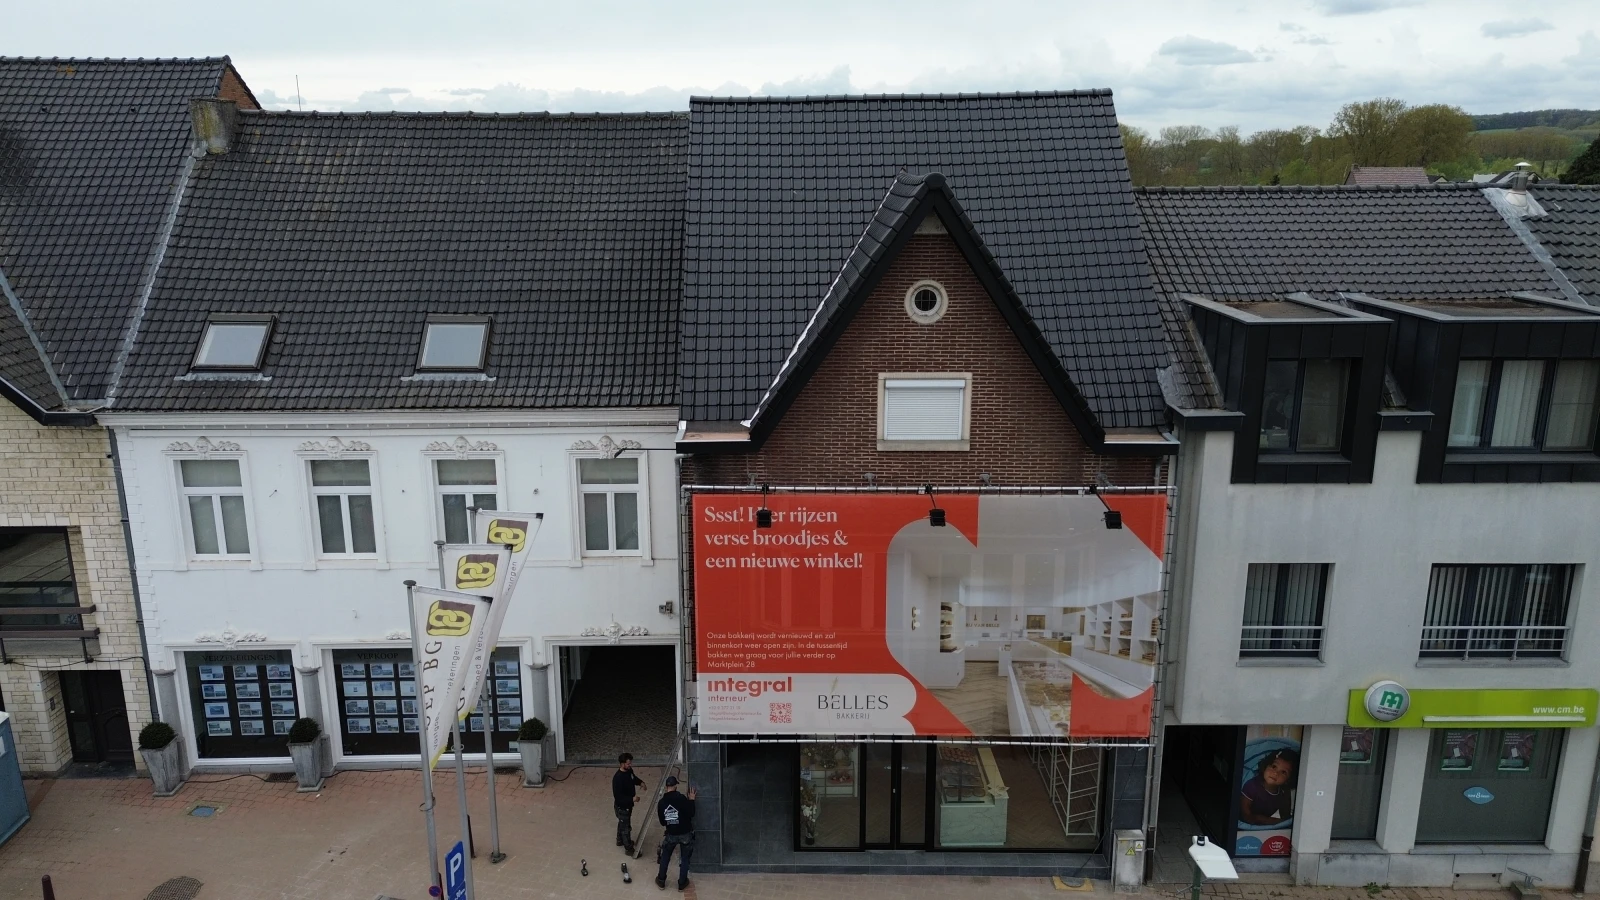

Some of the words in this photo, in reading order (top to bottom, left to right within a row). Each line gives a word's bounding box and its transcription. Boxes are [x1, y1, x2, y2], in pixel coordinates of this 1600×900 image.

[704, 506, 744, 523] Ssst!
[748, 506, 786, 523] Her
[789, 507, 838, 526] rijzen
[704, 533, 750, 546] verse
[752, 529, 830, 549] broodjes
[832, 529, 849, 546] &
[705, 556, 737, 568] een
[740, 553, 800, 568] nieuwe
[803, 552, 863, 568] winkel!
[727, 631, 755, 640] bakkerij
[706, 641, 743, 649] binnenkort
[782, 642, 797, 650] zijn.
[806, 641, 815, 649] de
[816, 641, 848, 650] tussentijd
[202, 654, 276, 662] VERZEKERINGEN
[357, 652, 399, 660] VERKOOP
[707, 651, 732, 659] bakken
[785, 651, 801, 660] jullie
[802, 651, 825, 659] verder
[707, 661, 744, 669] Marktplein
[708, 676, 793, 698] integral
[708, 694, 748, 702] interieur
[817, 694, 889, 710] BELLES
[1532, 705, 1585, 714] www.cm.be
[836, 712, 870, 720] BAKKERIJ
[450, 852, 462, 888] P
